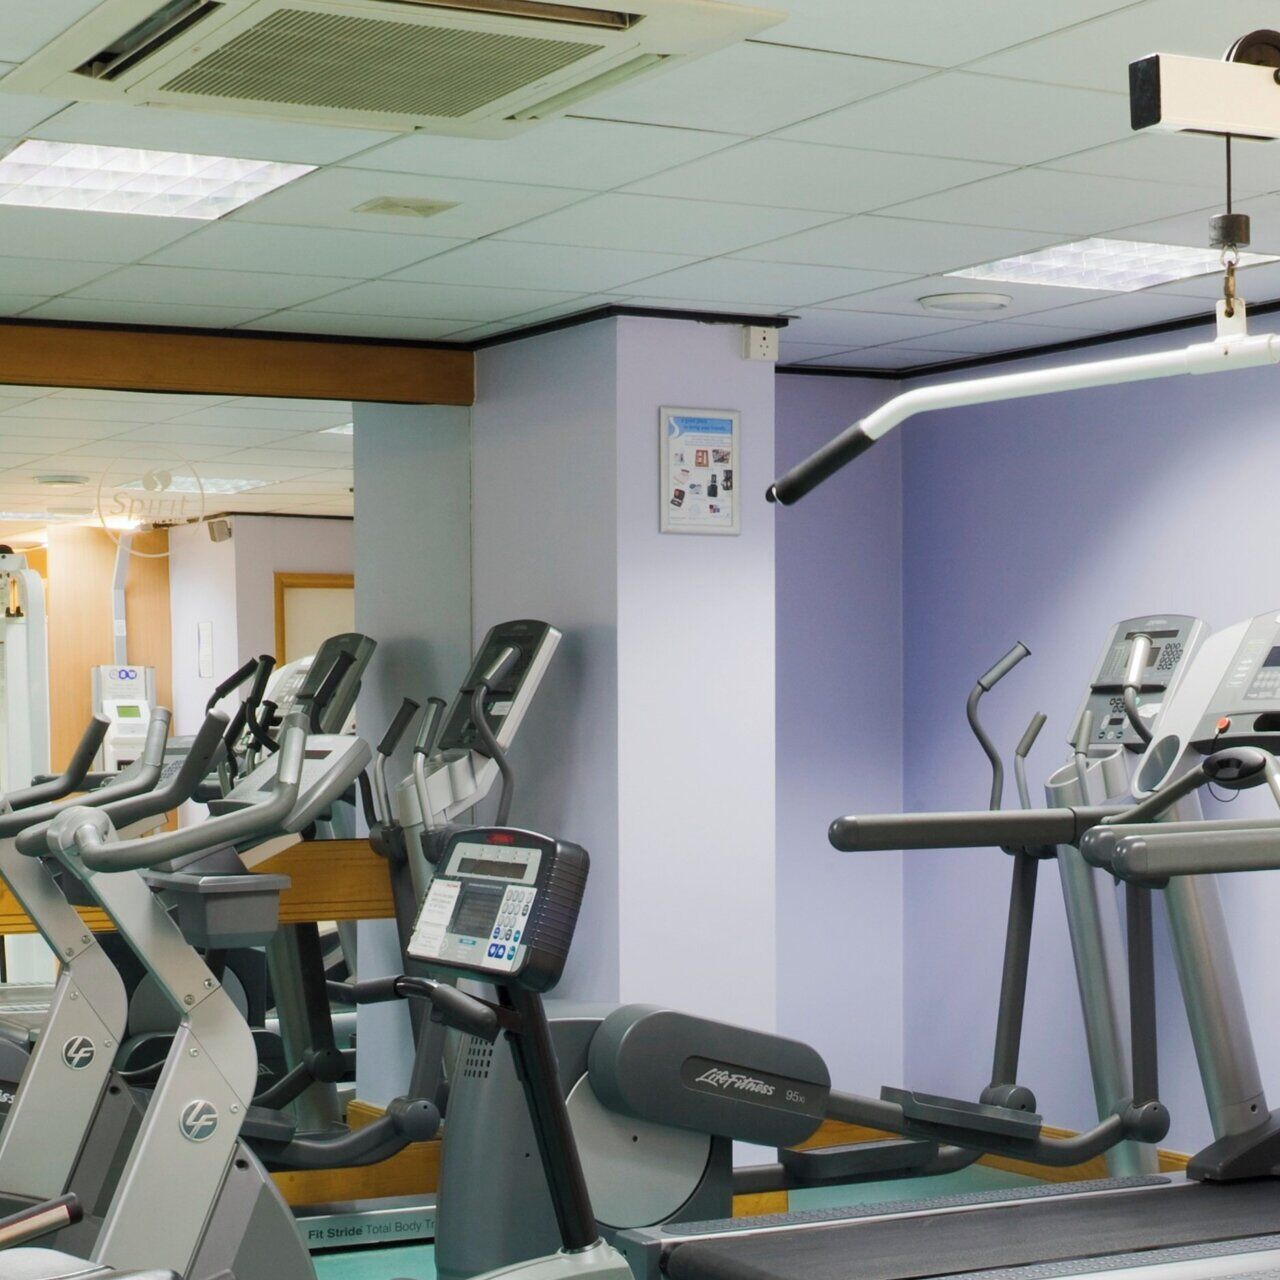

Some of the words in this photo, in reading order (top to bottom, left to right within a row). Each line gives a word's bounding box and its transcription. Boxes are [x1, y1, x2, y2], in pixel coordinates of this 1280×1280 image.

[308, 1229, 324, 1240] Fit
[327, 1226, 363, 1238] Stride
[366, 1223, 391, 1234] Total
[394, 1220, 422, 1233] Body
